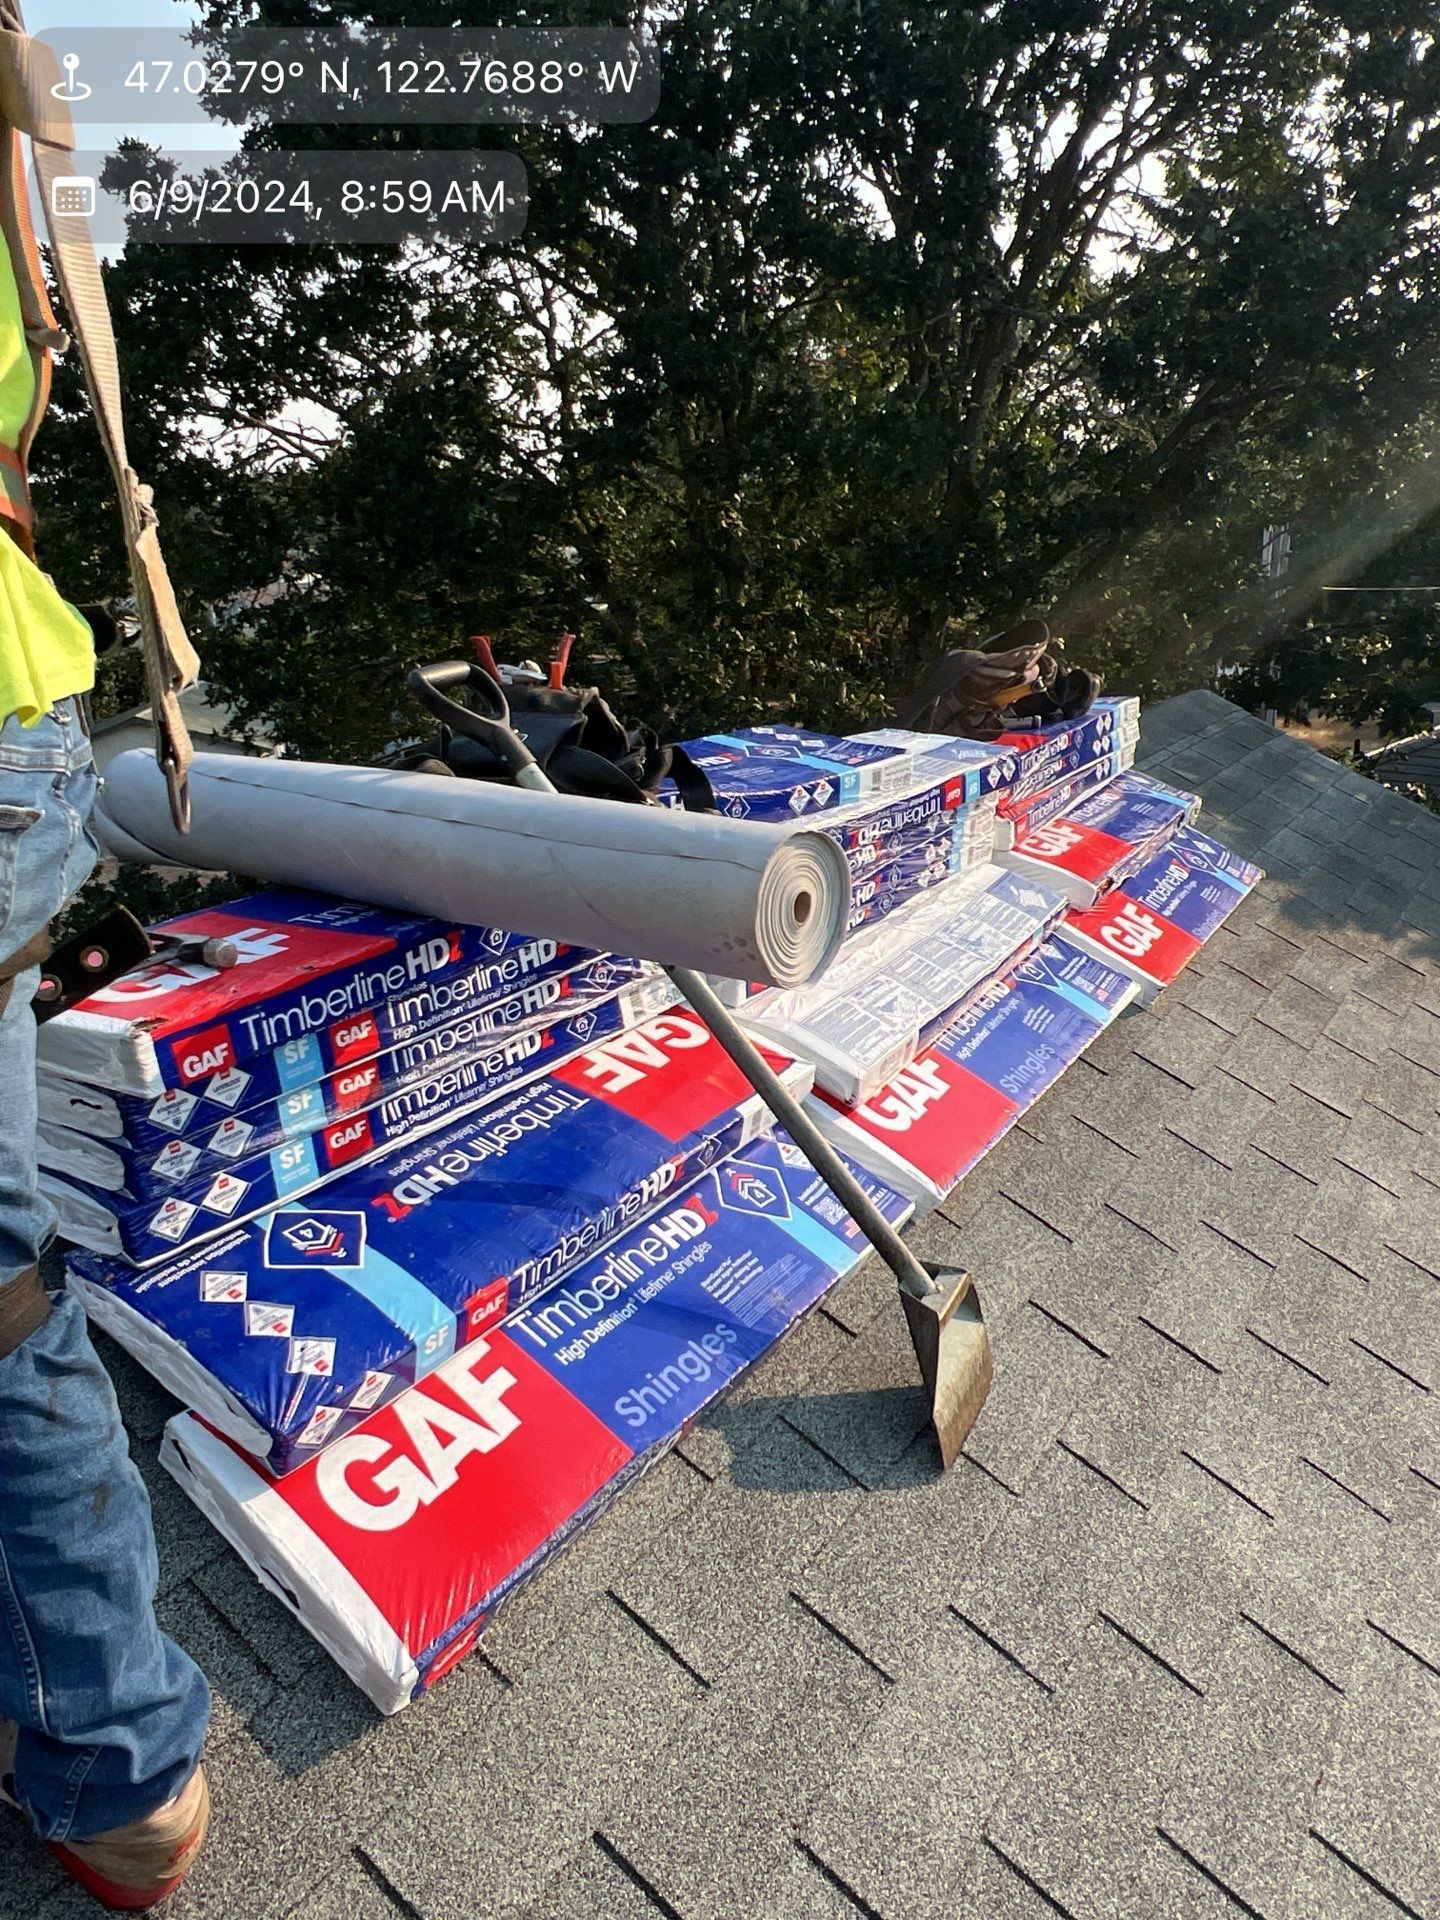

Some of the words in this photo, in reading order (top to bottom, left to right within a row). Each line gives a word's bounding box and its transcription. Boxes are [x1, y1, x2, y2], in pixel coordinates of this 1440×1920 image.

[1017, 825, 1084, 857] GAF
[1100, 902, 1164, 957] GAF
[283, 1037, 310, 1064] SF
[336, 1020, 372, 1047] GAF
[183, 1042, 229, 1079] GAF
[584, 1015, 711, 1093] GAF
[999, 1043, 1056, 1094] Shingles
[339, 1068, 376, 1095] GAF
[859, 1059, 950, 1132] GAF
[330, 1120, 366, 1149] GAF
[280, 1143, 306, 1169] SF
[471, 1292, 506, 1325] GAF
[554, 1339, 590, 1366] High
[671, 1241, 713, 1275] Shingles
[425, 1324, 449, 1354] SF
[615, 1322, 738, 1428] Shingles
[316, 1338, 523, 1531] GAF
